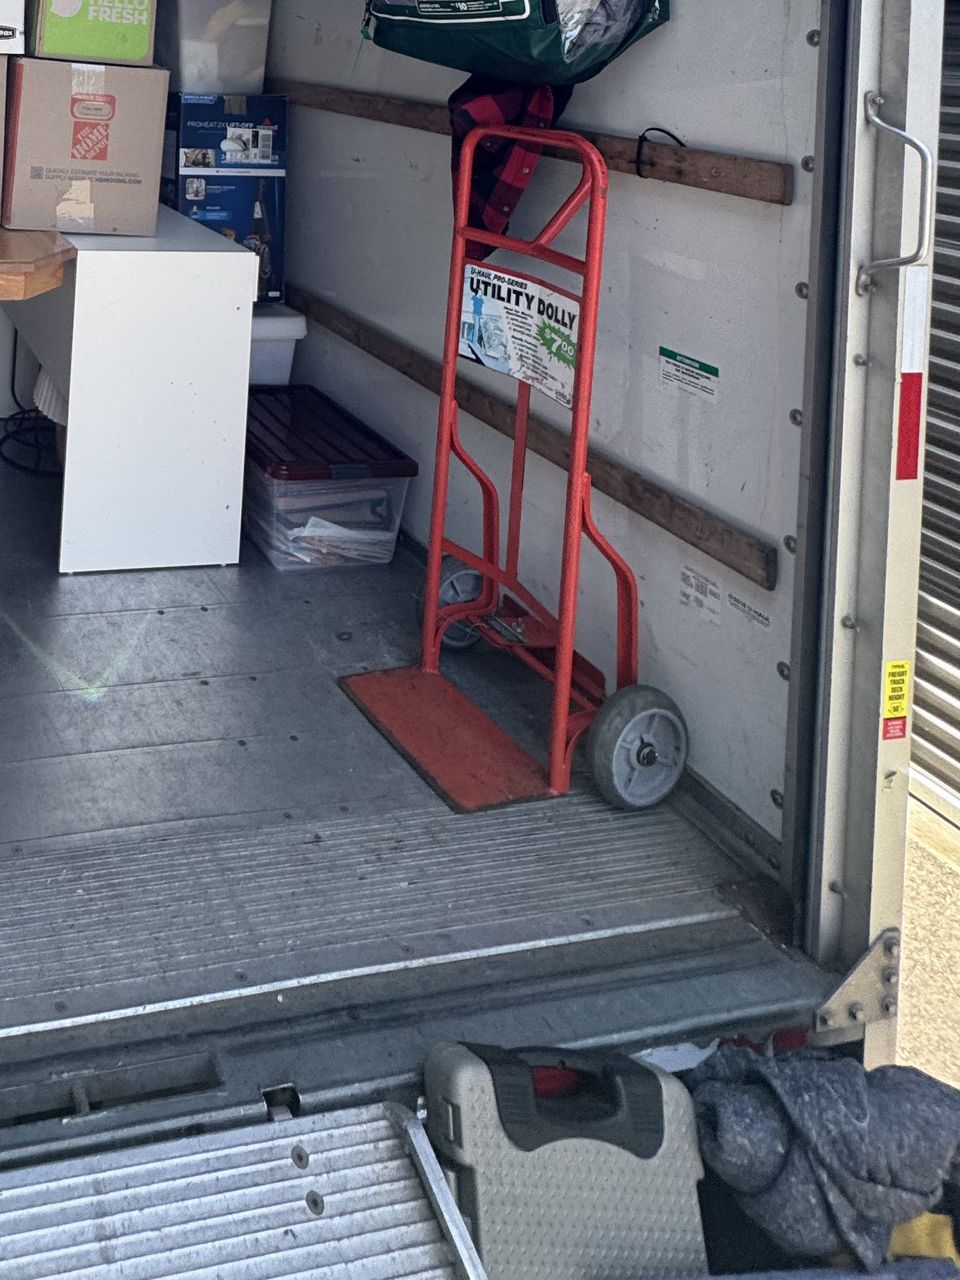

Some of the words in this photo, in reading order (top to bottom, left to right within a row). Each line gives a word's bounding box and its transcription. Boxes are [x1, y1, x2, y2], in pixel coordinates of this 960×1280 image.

[88, 6, 148, 25] FRESH
[71, 122, 110, 160] HOME
[76, 126, 90, 141] THE
[85, 138, 109, 160] DEPOT
[470, 267, 492, 281] U-HAUL
[493, 274, 528, 290] PRO-SERIES
[470, 277, 534, 311] UTILITY
[537, 296, 577, 332] DOLLY
